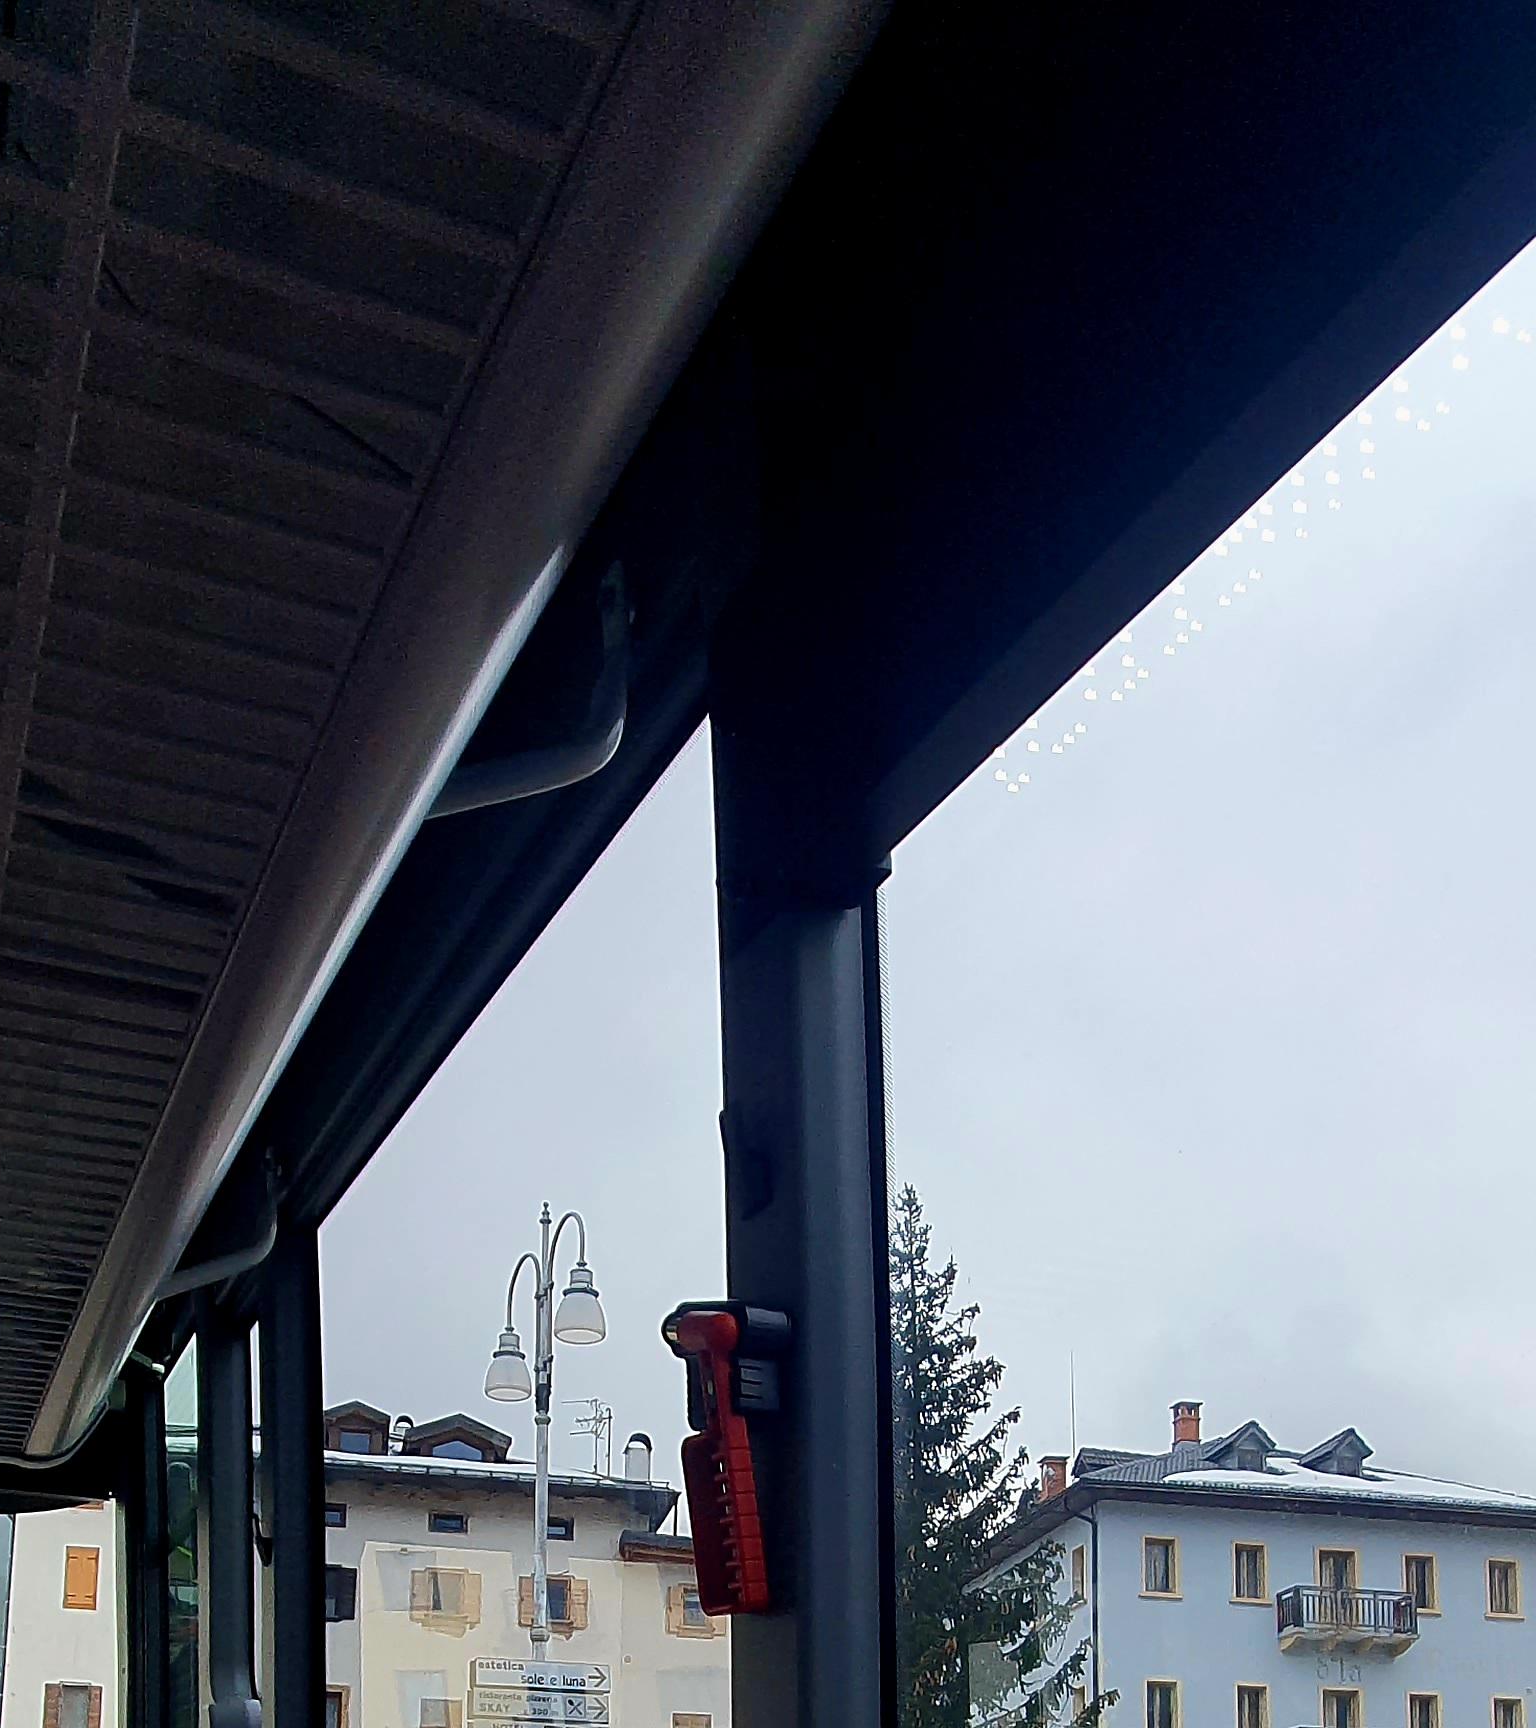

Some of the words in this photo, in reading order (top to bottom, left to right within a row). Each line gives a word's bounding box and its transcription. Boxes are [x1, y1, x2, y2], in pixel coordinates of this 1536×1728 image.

[478, 1660, 525, 1672] estetica
[549, 1676, 558, 1685] e
[562, 1674, 587, 1688] luna
